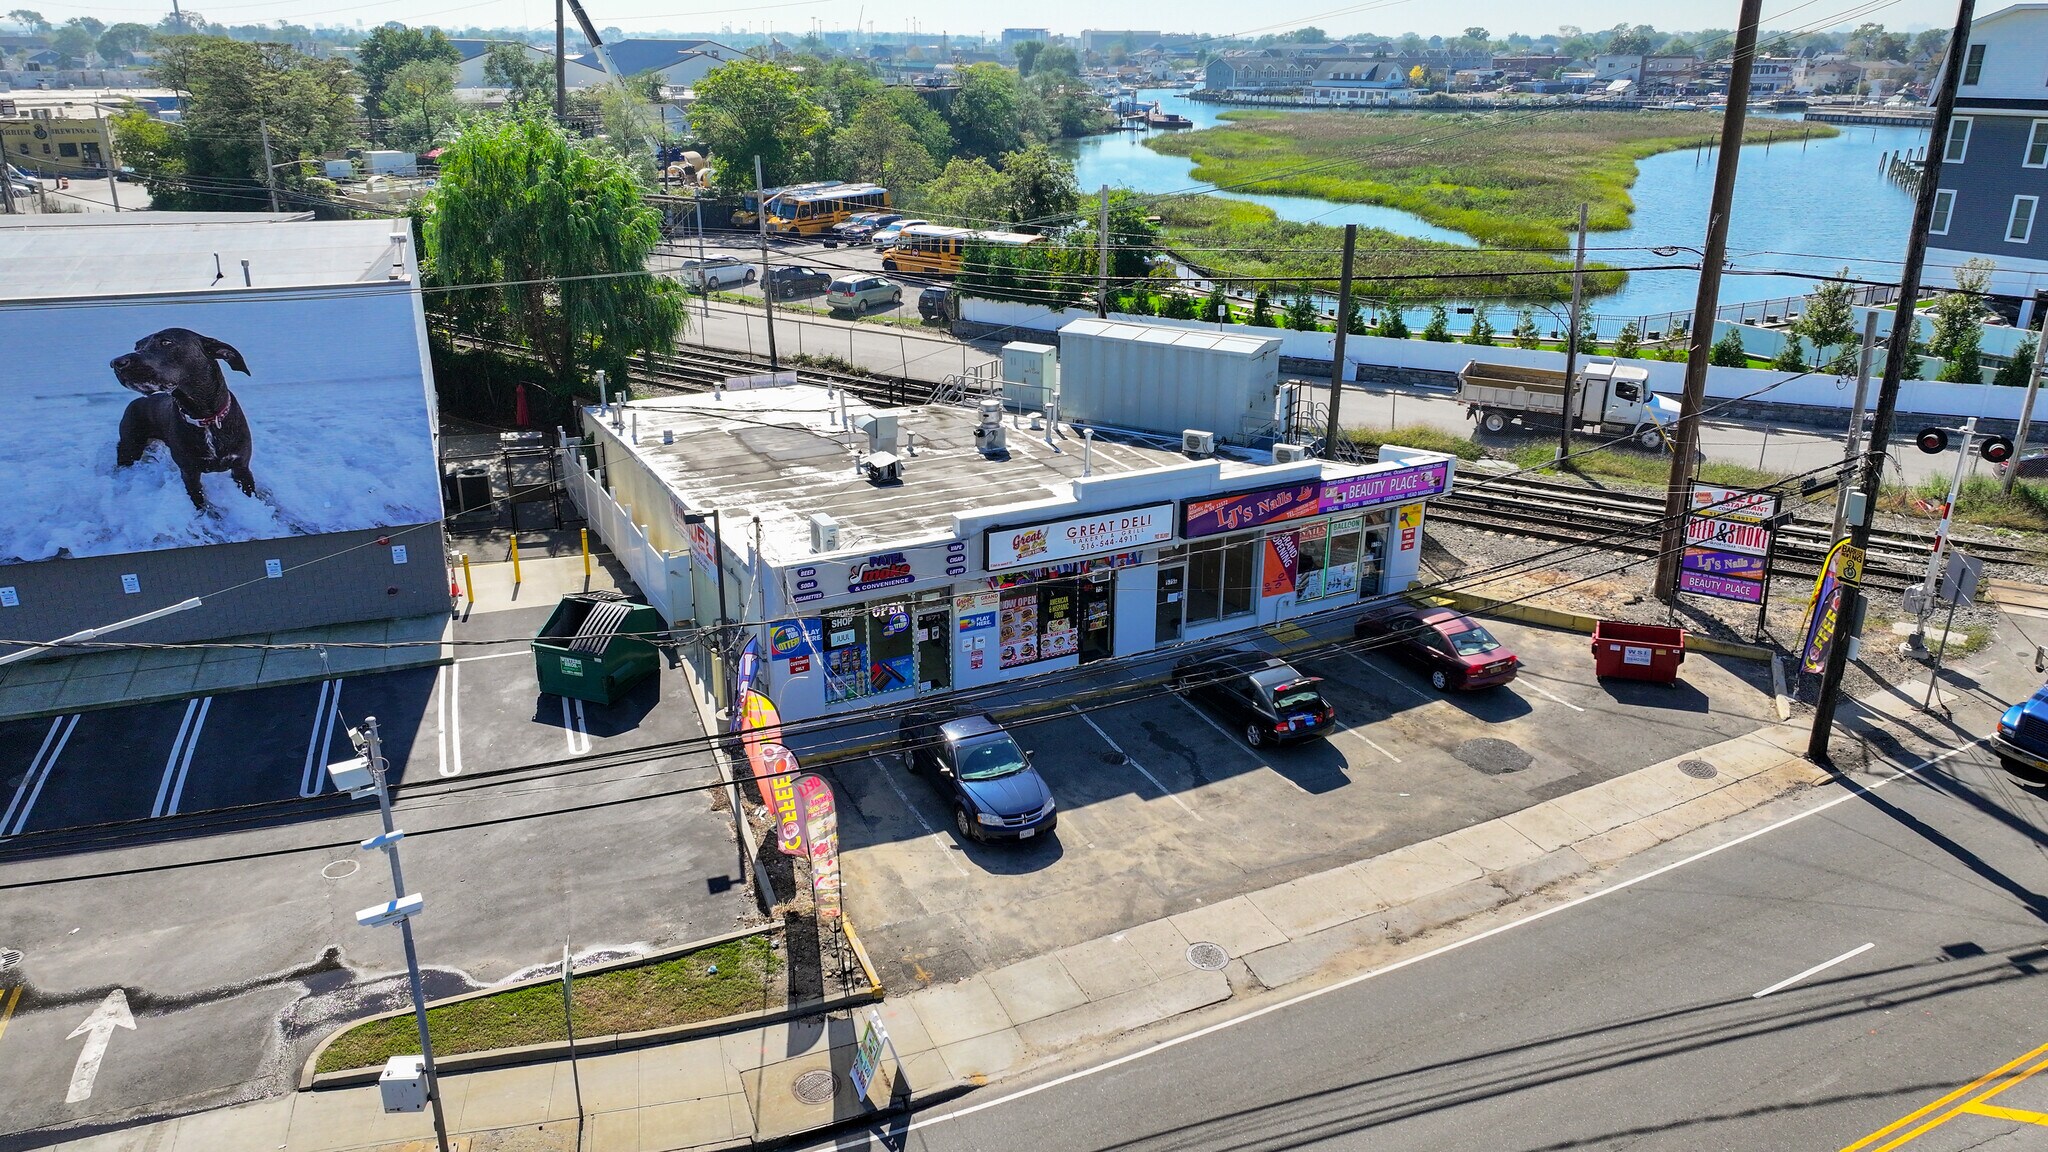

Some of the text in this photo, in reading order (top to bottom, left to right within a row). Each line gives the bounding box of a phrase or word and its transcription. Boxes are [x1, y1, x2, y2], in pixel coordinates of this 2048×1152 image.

[1349, 475, 1419, 499] BEAUTY PLACE
[1257, 491, 1293, 517] Nails
[1724, 491, 1765, 504] DELI
[1720, 501, 1769, 512] ESTAURANT
[1066, 514, 1152, 538] GREAT DELI
[1333, 520, 1360, 531] BALLOON
[1012, 529, 1042, 550] Great
[1072, 534, 1103, 545] BAKERY
[1121, 527, 1145, 536] GRILL
[1689, 517, 1770, 549] BEER & SMOKE
[950, 543, 963, 551] VAPE
[1080, 534, 1138, 551] 516-544-4911
[869, 552, 907, 568] PATEL
[949, 555, 964, 563] CIGAR
[1724, 558, 1749, 570] Nails
[800, 569, 815, 577] BEER
[949, 567, 964, 576] LOTTO
[800, 582, 815, 590] SODA
[861, 577, 909, 591] CONVENIENCE
[1689, 577, 1722, 590] BEAUTY
[1725, 583, 1751, 596] PLACE
[795, 592, 823, 603] CIGARETTES
[980, 593, 998, 601] GRAND
[1000, 598, 1018, 610] NOW
[1018, 595, 1037, 607] OPEN
[1049, 596, 1069, 606] AMERICAN
[872, 602, 905, 618] OPEN
[1053, 611, 1064, 619] FOOD
[831, 616, 853, 629] SHOP
[802, 628, 820, 637] PLAY
